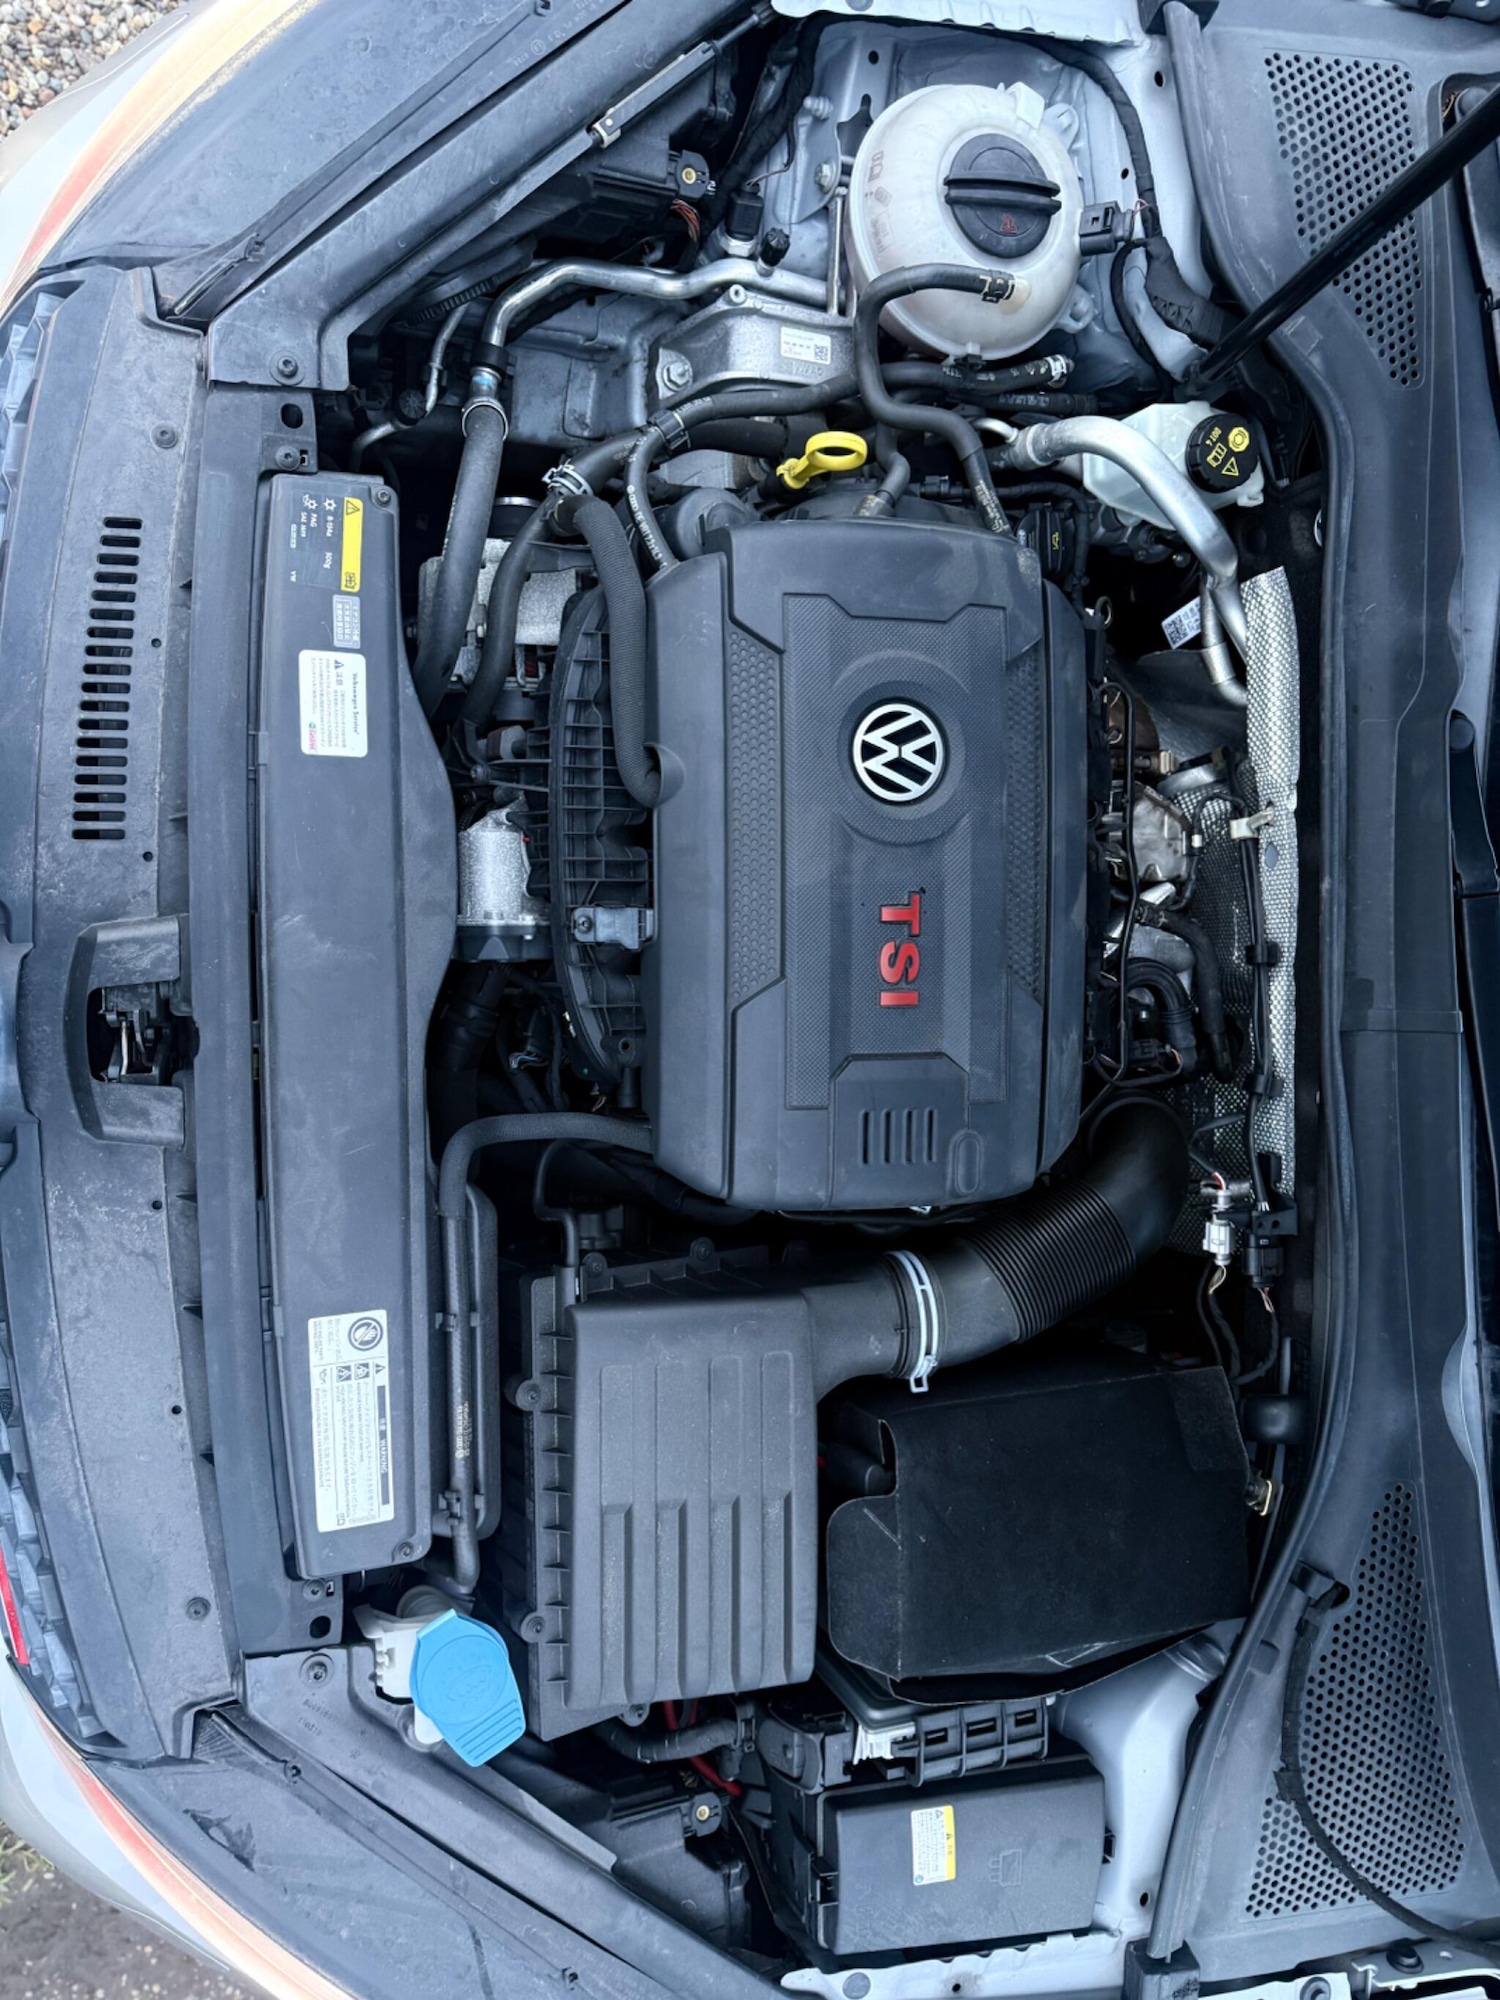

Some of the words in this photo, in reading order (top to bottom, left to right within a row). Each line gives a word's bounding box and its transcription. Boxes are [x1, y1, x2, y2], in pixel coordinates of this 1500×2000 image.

[1209, 426, 1222, 443] DOT
[351, 672, 359, 710] Volkswagen
[880, 893, 921, 1007] TSI
[380, 1438, 388, 1474] WARNING
